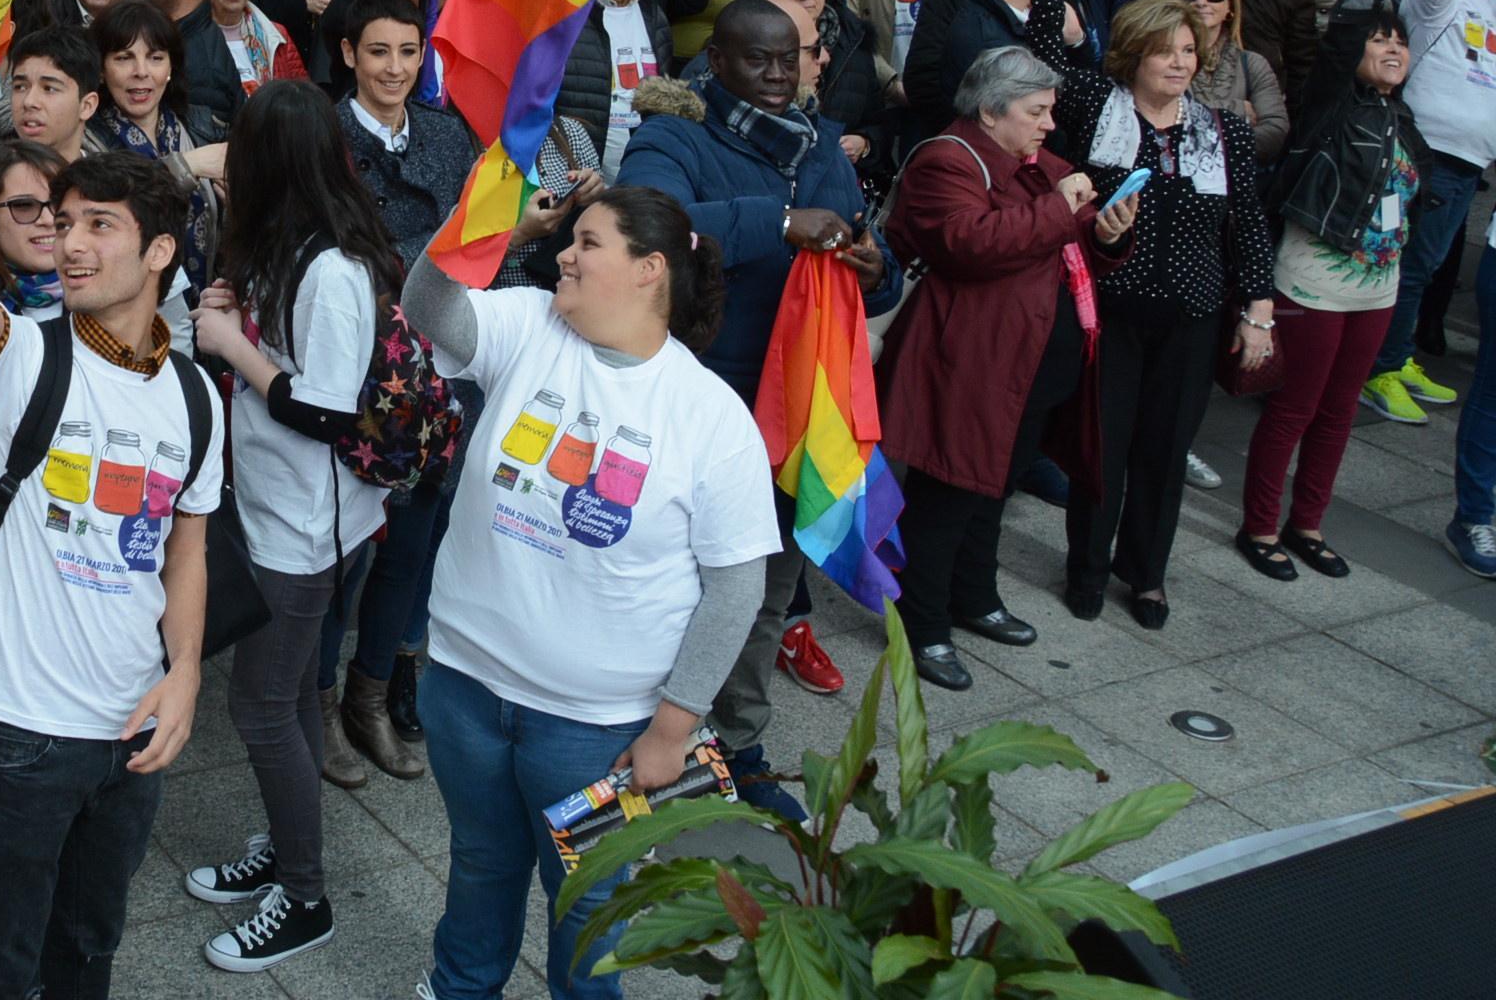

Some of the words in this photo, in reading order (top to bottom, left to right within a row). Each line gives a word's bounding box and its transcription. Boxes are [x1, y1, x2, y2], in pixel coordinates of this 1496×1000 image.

[516, 511, 524, 520] 21
[524, 515, 547, 532] MARZO
[547, 526, 563, 538] 2017
[75, 555, 85, 565] 21
[85, 558, 111, 572] MARZO
